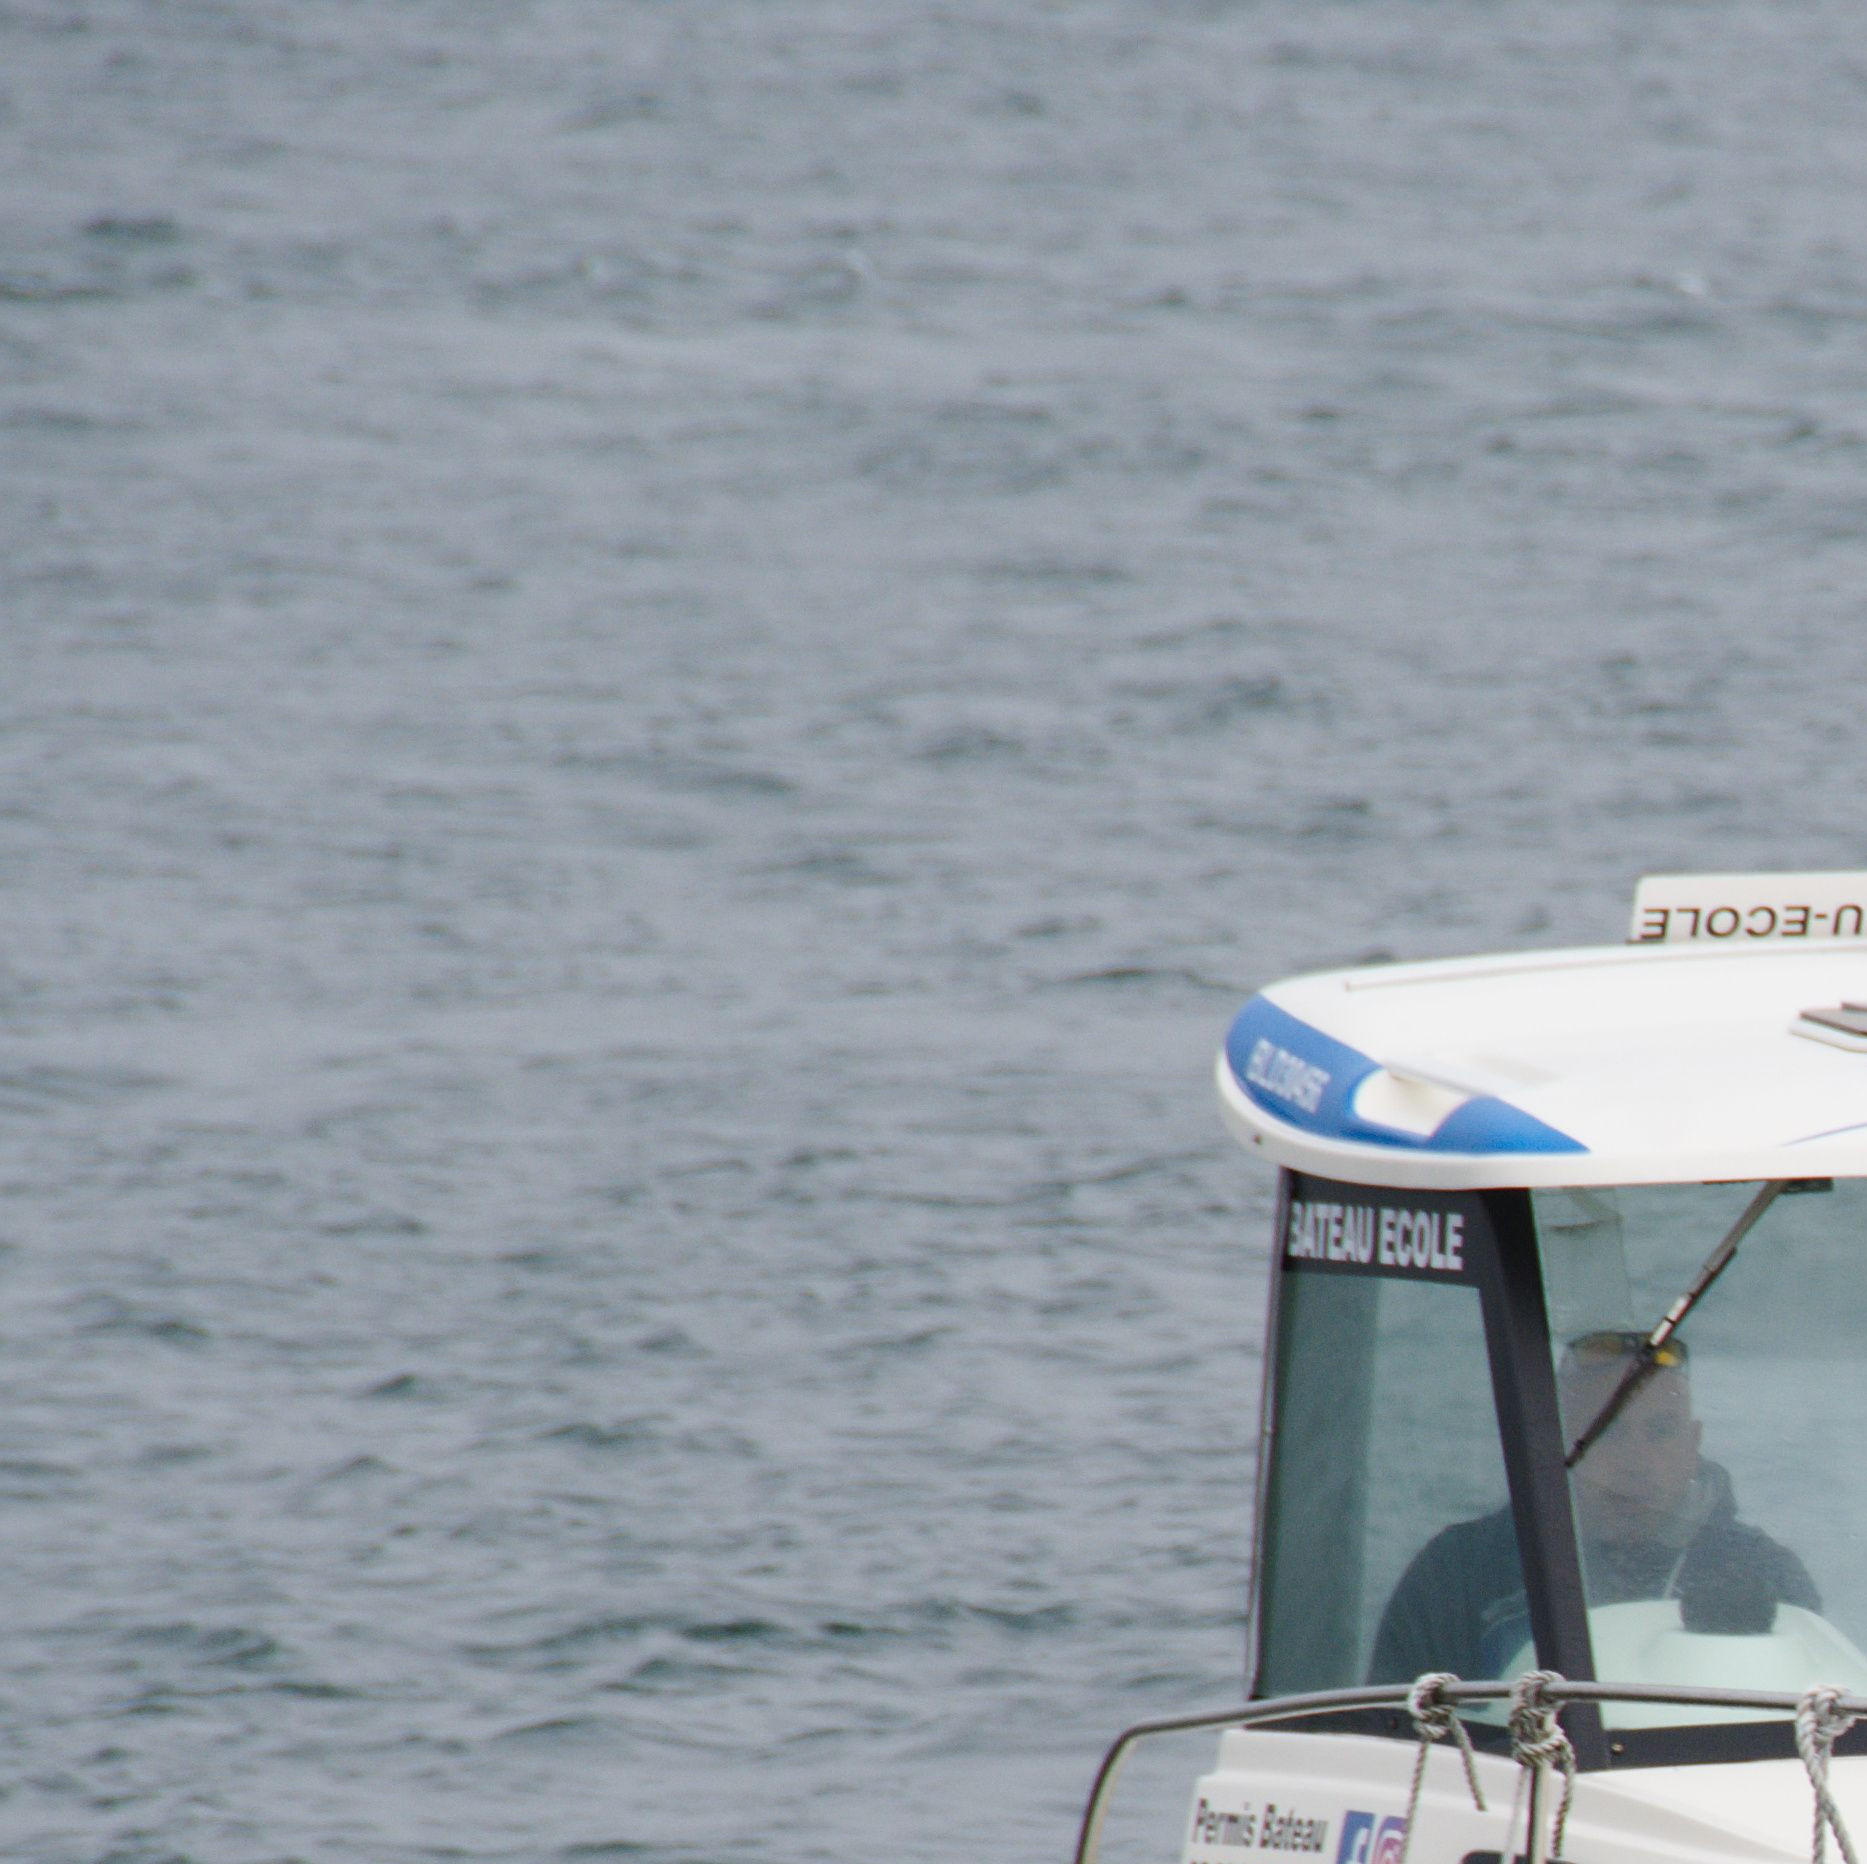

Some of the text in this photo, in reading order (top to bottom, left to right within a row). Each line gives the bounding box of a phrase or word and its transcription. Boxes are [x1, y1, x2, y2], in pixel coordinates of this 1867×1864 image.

[1378, 1208, 1464, 1271] ECOLE
[1192, 1798, 1328, 1853] Permis Bateau
